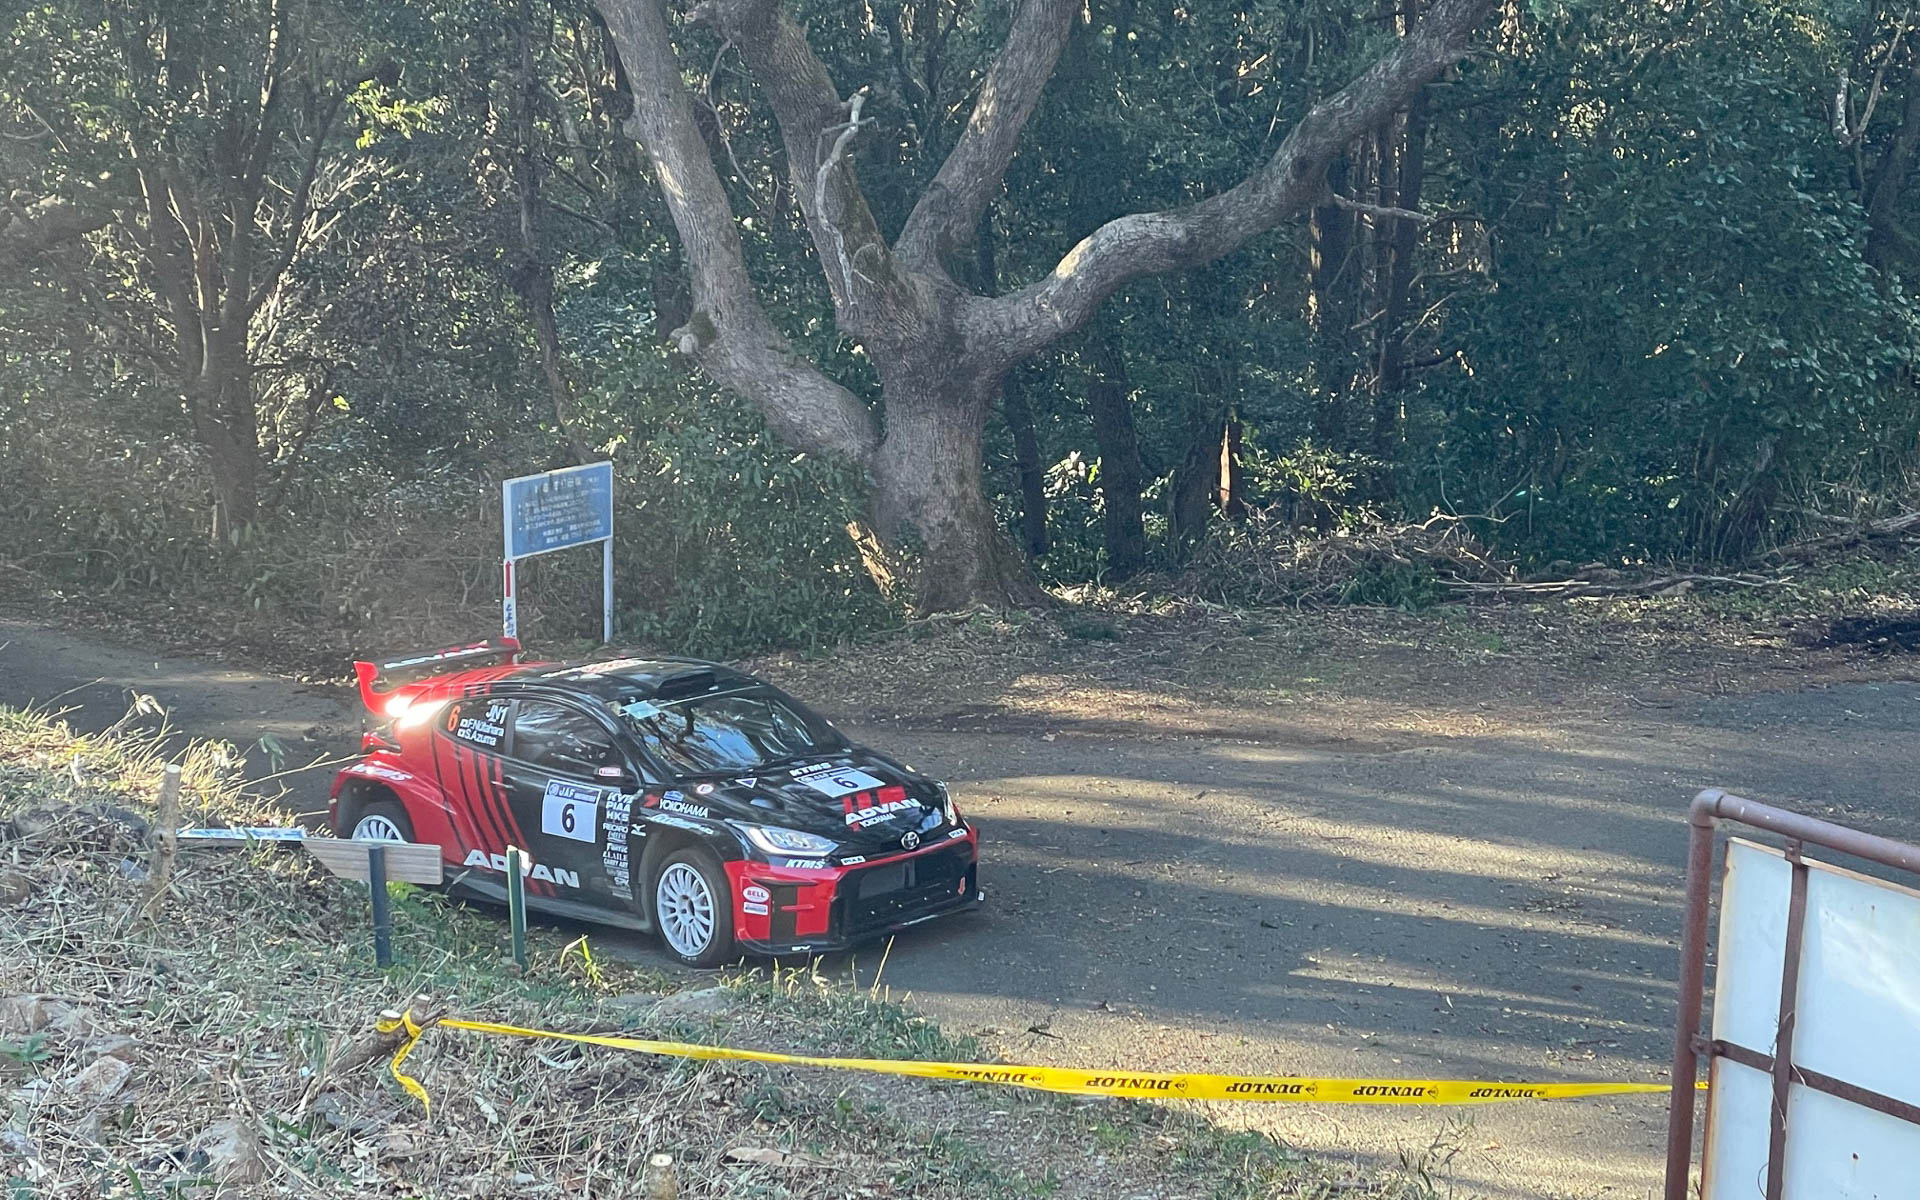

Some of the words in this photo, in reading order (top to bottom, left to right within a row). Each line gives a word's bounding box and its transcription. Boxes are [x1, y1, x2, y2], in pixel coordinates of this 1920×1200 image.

[447, 705, 461, 732] 6
[486, 705, 509, 724] JN1
[789, 762, 831, 776] KTMS
[832, 777, 859, 788] 6
[558, 787, 576, 798] JAF
[606, 801, 630, 813] PIAA
[659, 799, 709, 818] YOKOHAMA
[845, 798, 921, 825] ADVAN
[561, 803, 575, 833] 6
[606, 810, 629, 822] HKS
[785, 859, 826, 869] KTMS
[746, 890, 766, 898] BELL
[1086, 1077, 1172, 1090] DUNLOP
[1226, 1082, 1302, 1095] DUNLOP
[1353, 1085, 1425, 1097] DUNLOP
[1470, 1088, 1535, 1098] DUNLOP
